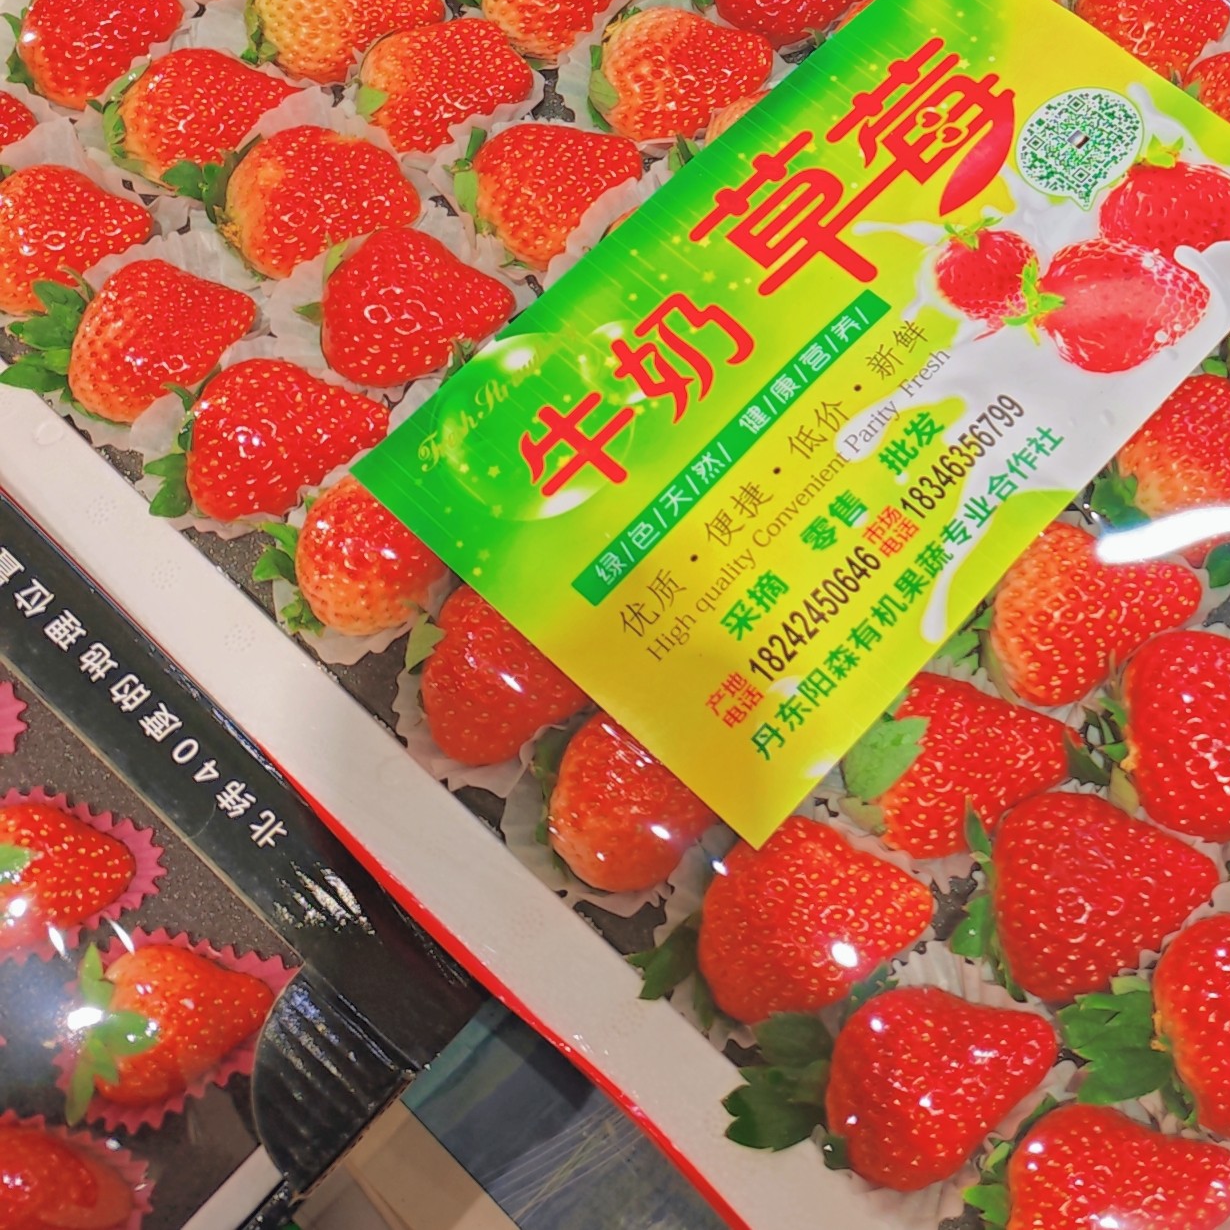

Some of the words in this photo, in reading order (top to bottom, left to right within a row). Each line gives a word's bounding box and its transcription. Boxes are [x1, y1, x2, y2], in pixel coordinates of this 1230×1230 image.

[518, 37, 1016, 498] 牛奶草莓
[646, 612, 697, 662] High
[696, 548, 756, 614] quality
[752, 450, 852, 549] Convenient
[843, 400, 901, 454] Parity
[900, 347, 951, 398] Fresh
[720, 569, 790, 642] 采摘
[799, 489, 869, 554] 零售
[877, 410, 945, 477] 批发
[748, 545, 881, 682] 18242450646
[900, 394, 1025, 519] 18346356799
[750, 425, 1065, 761] 丹东阳森有机果蔬专业合作社
